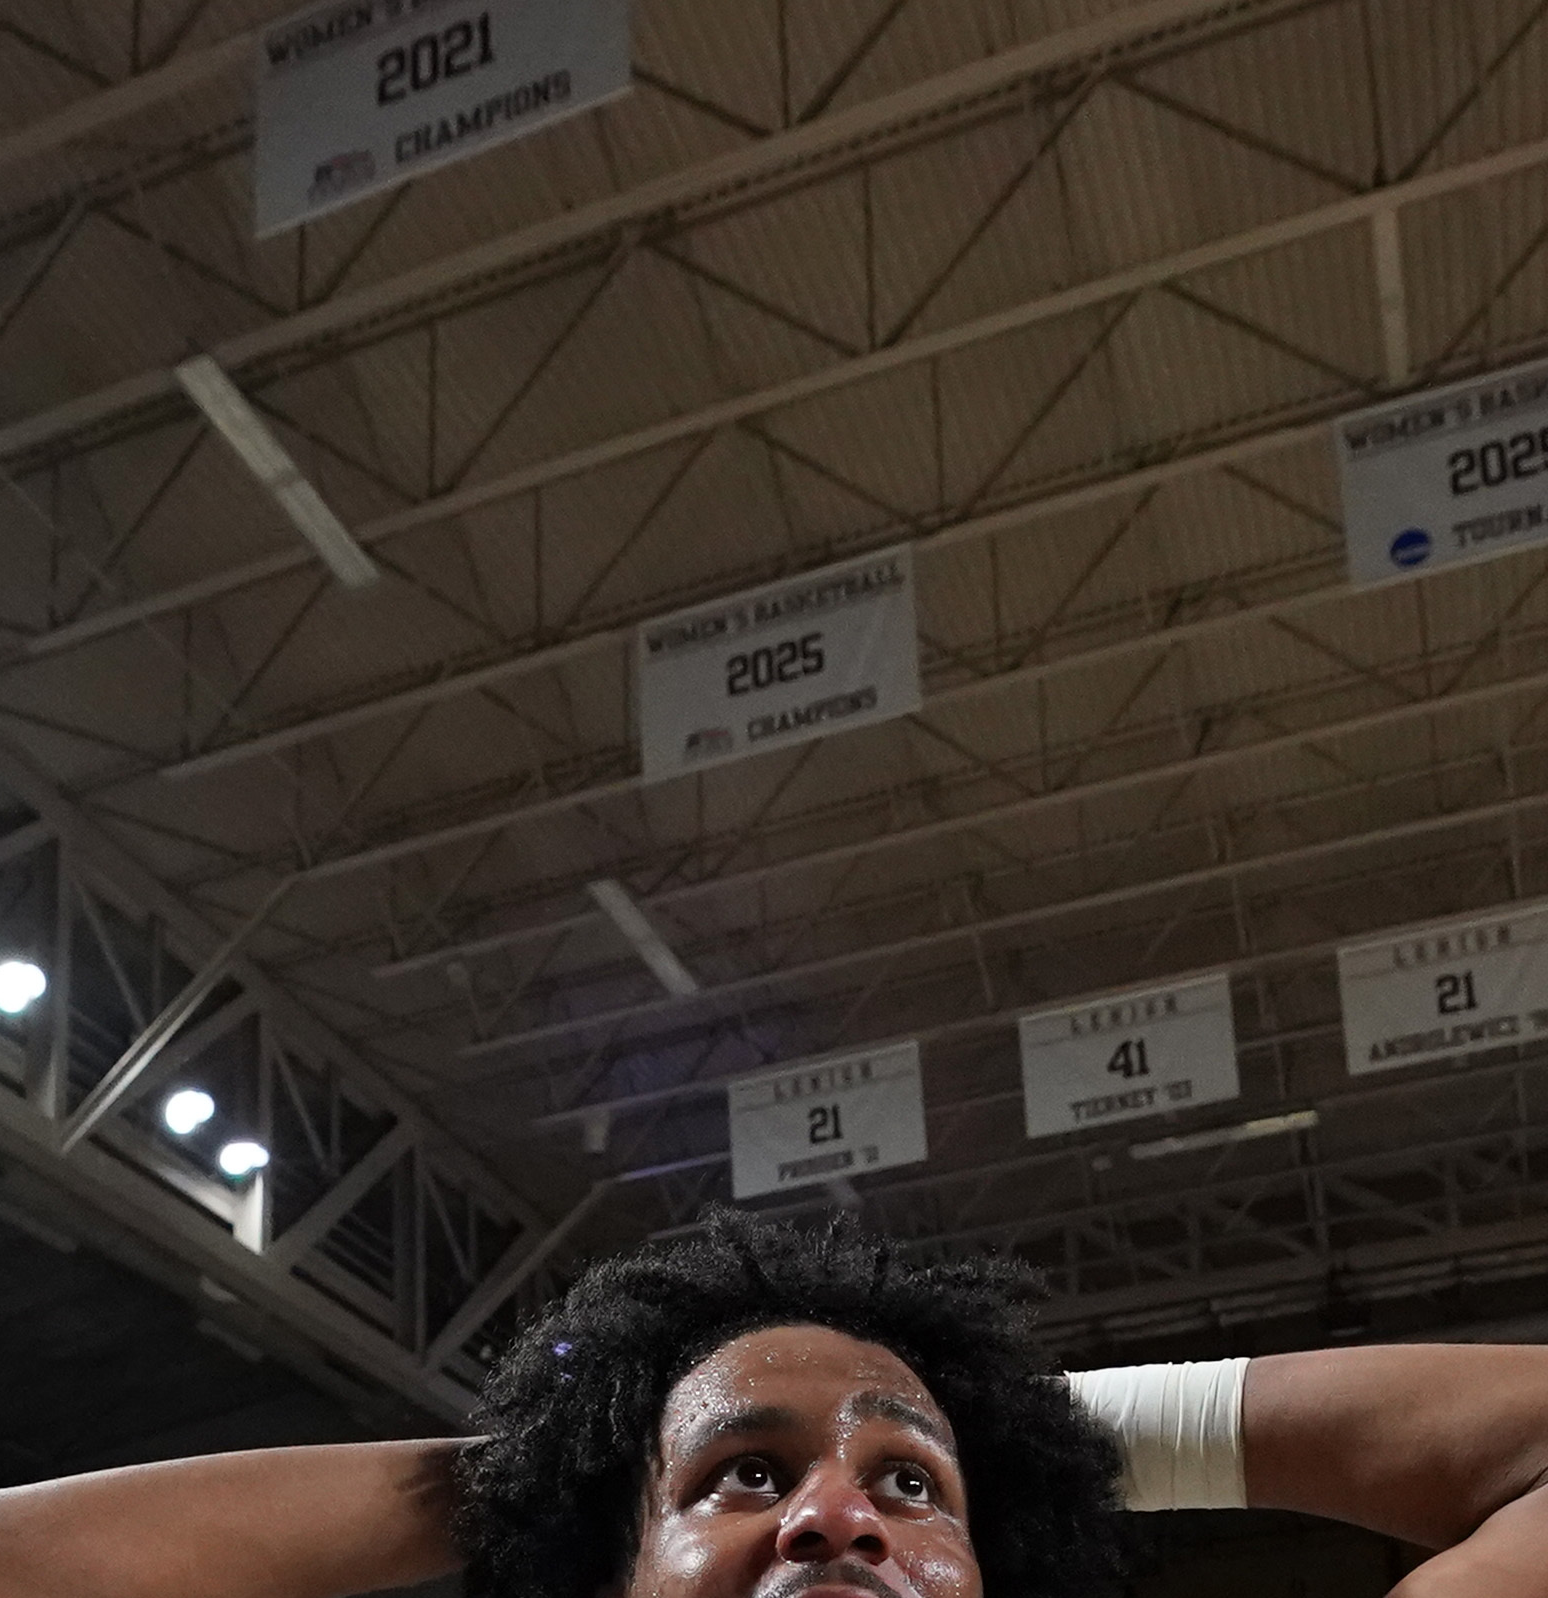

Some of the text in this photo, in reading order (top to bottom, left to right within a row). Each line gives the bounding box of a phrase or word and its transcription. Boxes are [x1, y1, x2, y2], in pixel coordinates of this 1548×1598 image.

[264, 0, 403, 64] WOMENS
[376, 12, 495, 106] 2021
[395, 69, 572, 163] CHAMPIONS
[725, 631, 825, 697] 2025
[1435, 970, 1478, 1015] 21
[1106, 1037, 1150, 1078] 41
[807, 1104, 844, 1144] 21
